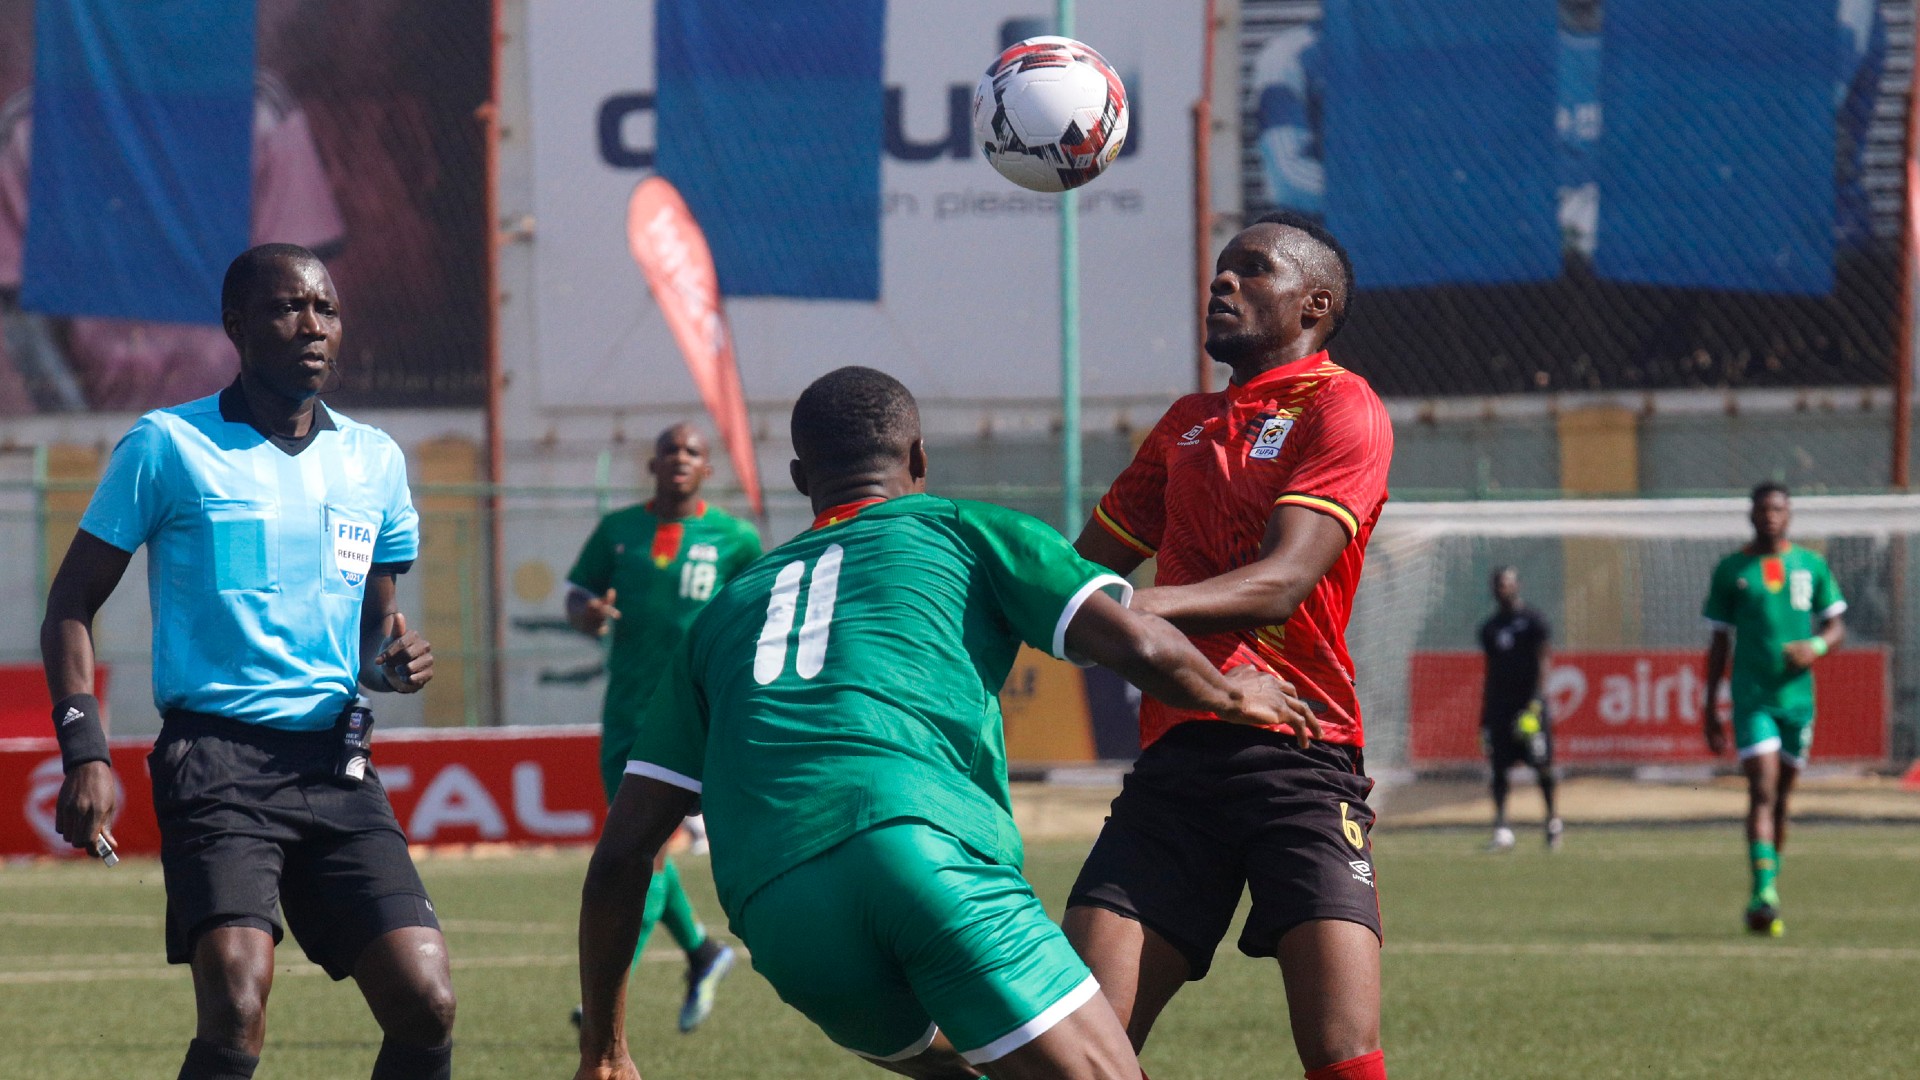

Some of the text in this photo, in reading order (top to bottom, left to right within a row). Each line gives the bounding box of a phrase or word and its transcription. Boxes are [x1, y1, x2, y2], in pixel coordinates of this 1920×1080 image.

[1254, 448, 1275, 457] FUFA
[338, 523, 371, 544] FIFA
[337, 548, 370, 563] REFEREE
[345, 572, 361, 583] 2021
[679, 561, 718, 602] 18
[753, 543, 844, 686] 11
[1339, 801, 1364, 849] 6
